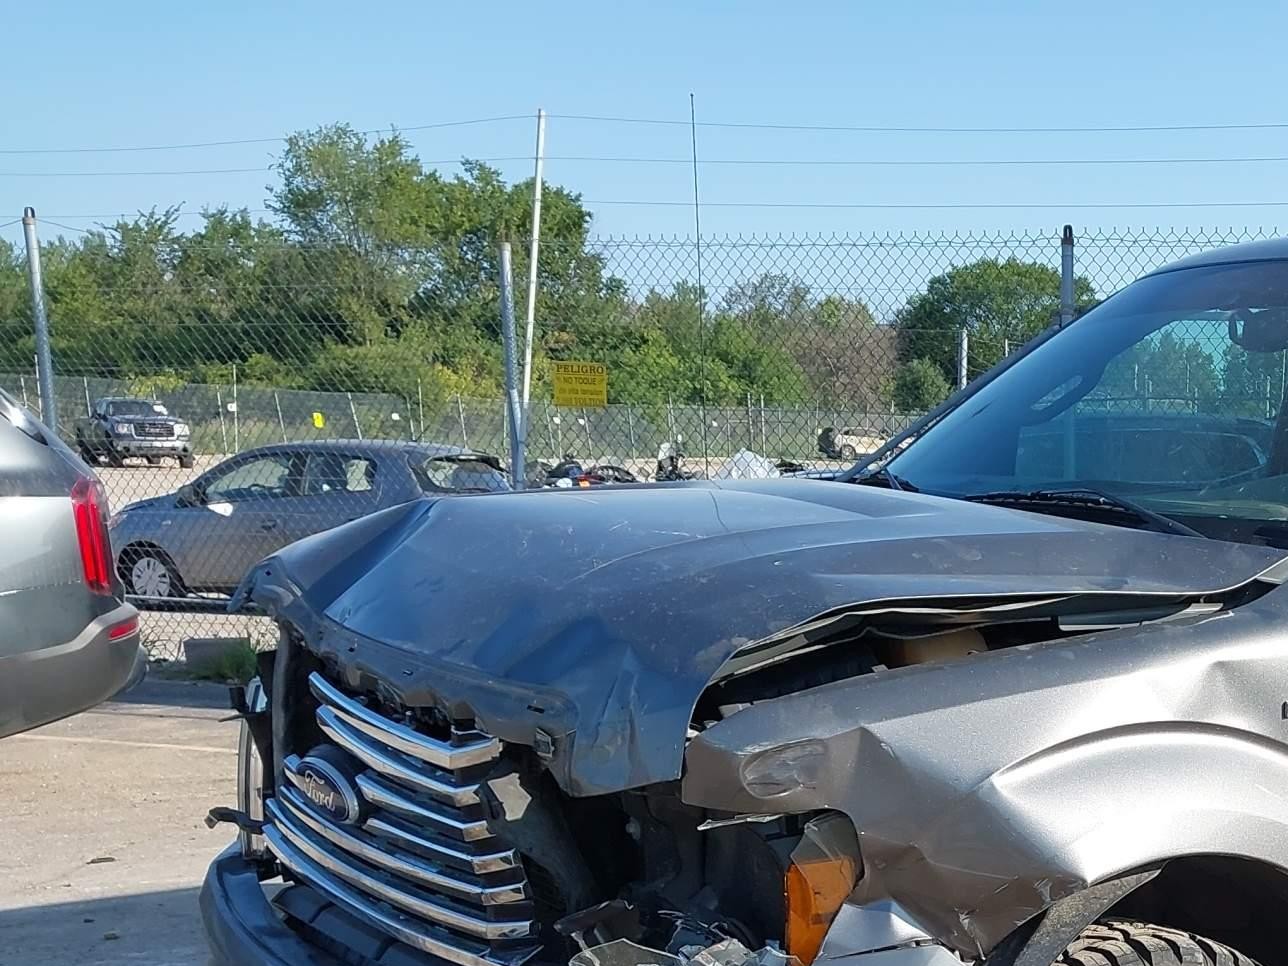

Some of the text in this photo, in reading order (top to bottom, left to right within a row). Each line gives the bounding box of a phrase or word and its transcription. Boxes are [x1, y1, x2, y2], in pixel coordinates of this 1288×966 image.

[556, 364, 604, 374] PELIGRO
[562, 376, 573, 385] NO
[303, 770, 336, 812] Ford
